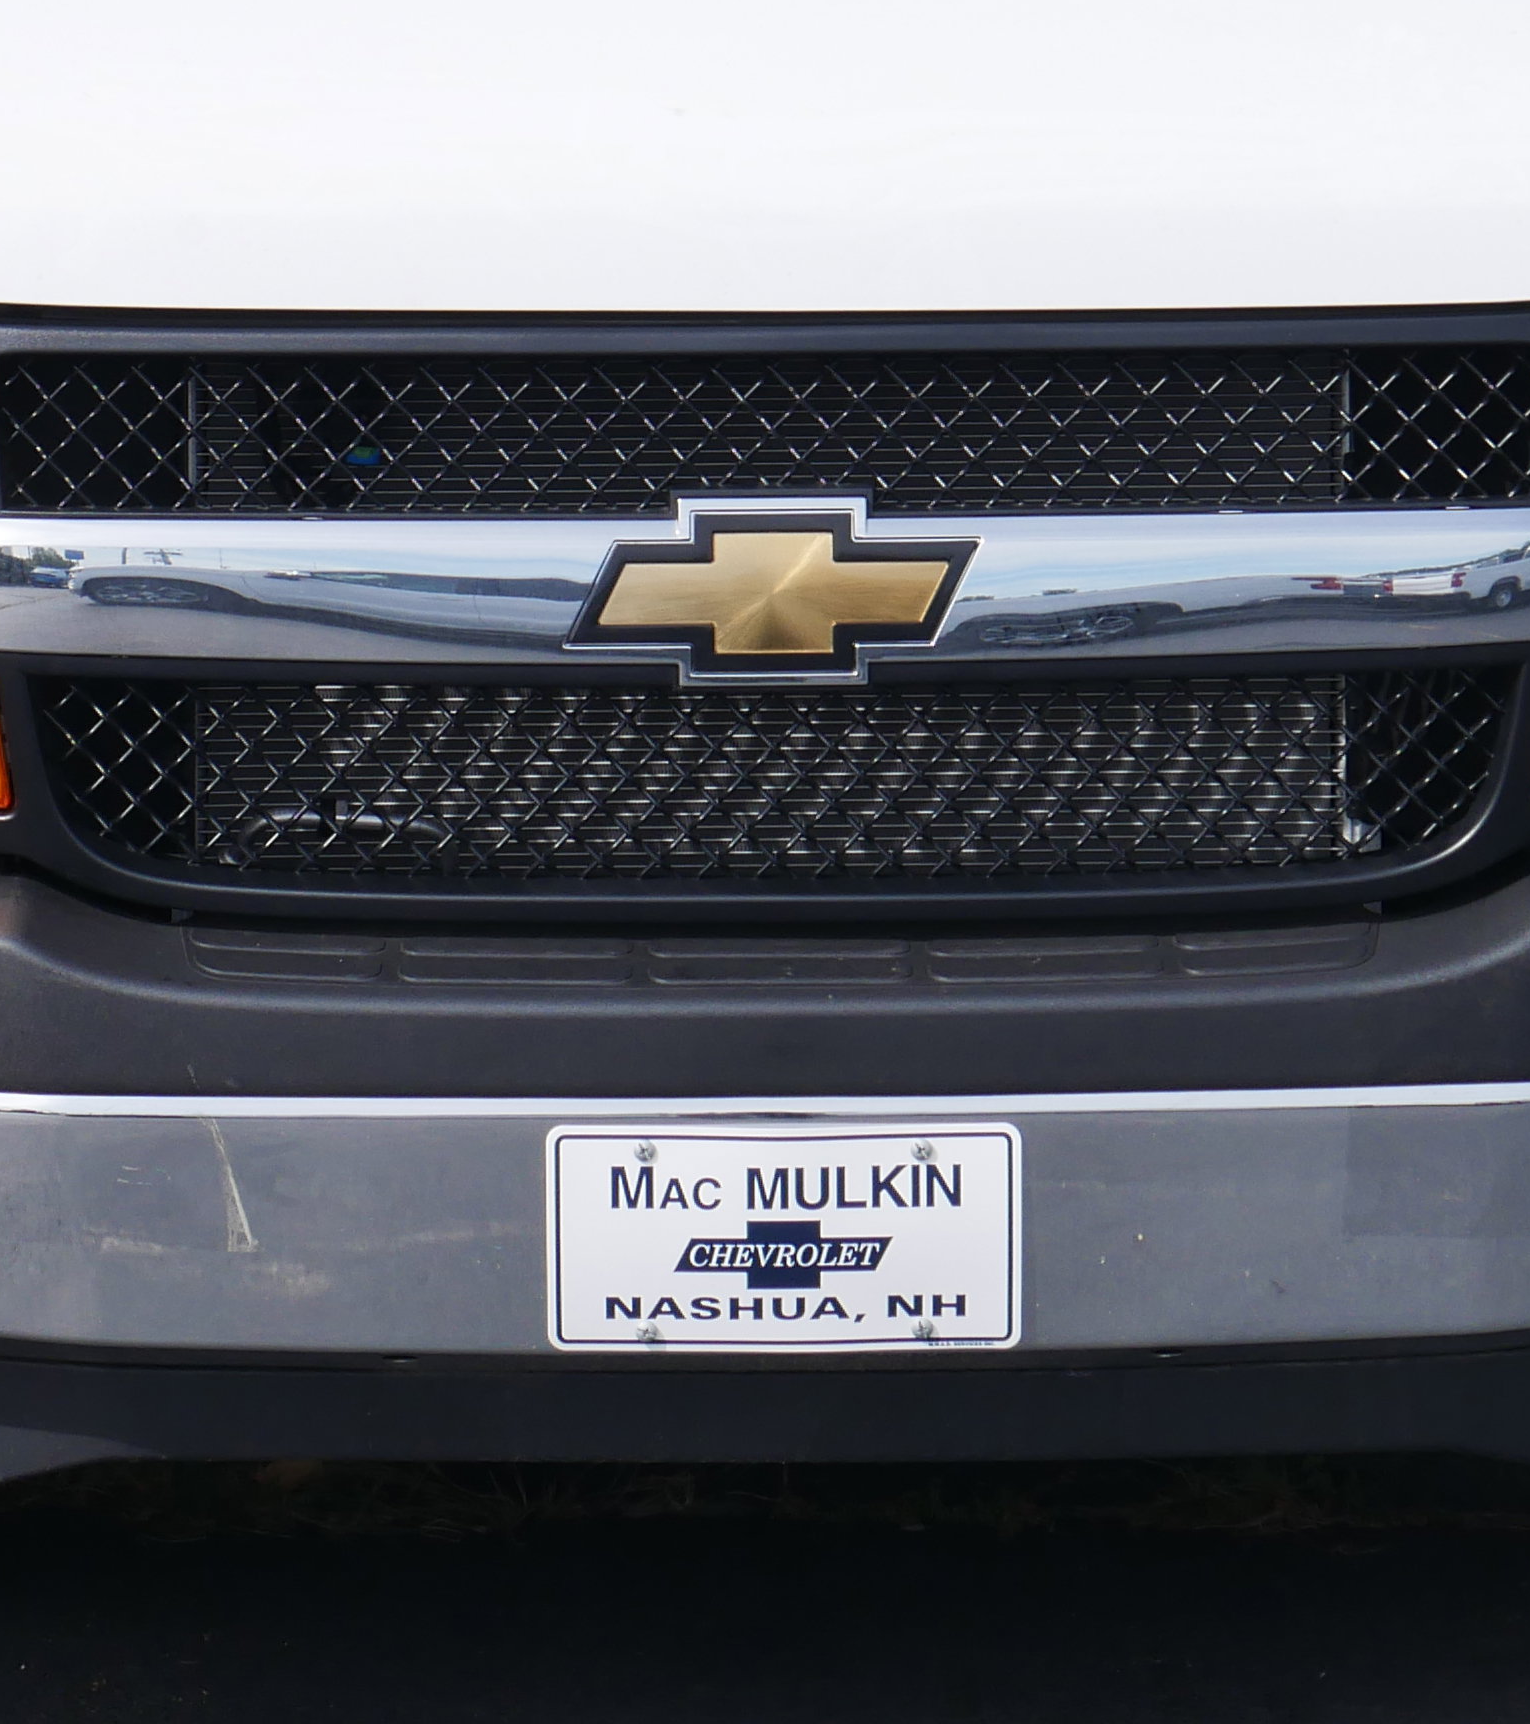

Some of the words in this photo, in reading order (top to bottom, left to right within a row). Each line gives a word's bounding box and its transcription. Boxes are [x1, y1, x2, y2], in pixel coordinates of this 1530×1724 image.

[746, 1164, 962, 1210] MULKIN
[688, 1241, 880, 1268] CHEVROLET
[605, 1295, 865, 1322] NASHUA,
[887, 1294, 967, 1317] NH
